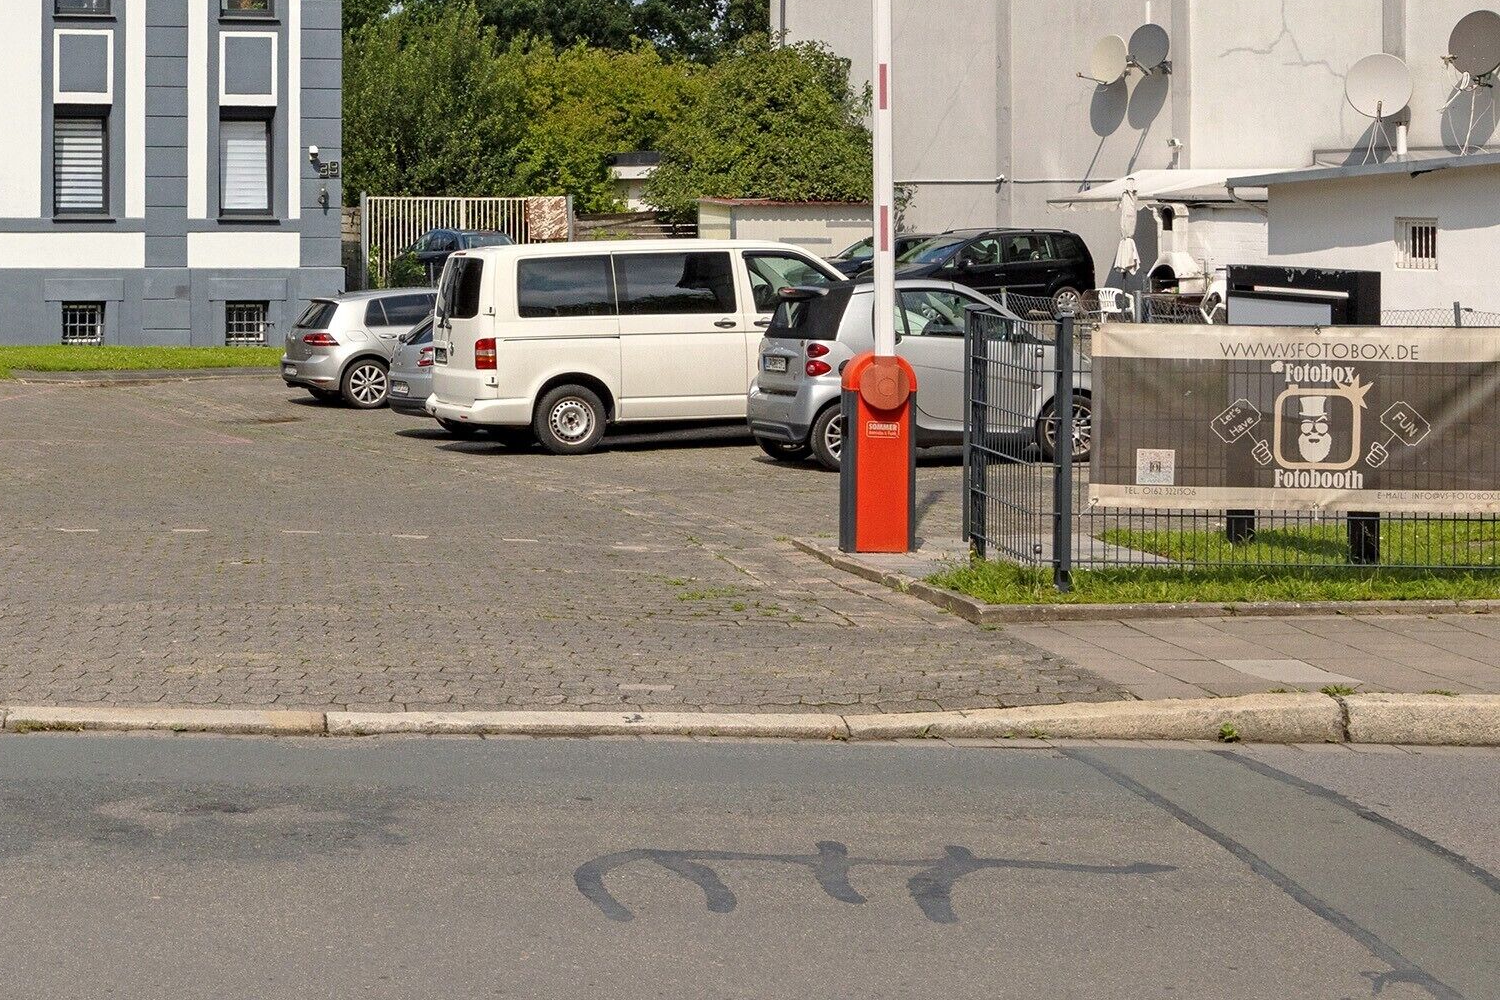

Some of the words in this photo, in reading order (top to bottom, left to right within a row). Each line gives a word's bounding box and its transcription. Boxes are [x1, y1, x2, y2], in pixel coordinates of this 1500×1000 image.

[320, 161, 339, 178] 39
[1220, 342, 1419, 360] WWW.VSFOTOBOX.DE
[1285, 363, 1355, 383] Fotobox
[1219, 407, 1242, 425] Let's
[1392, 411, 1419, 437] FUN
[868, 423, 898, 431] SOMMER
[1229, 416, 1254, 437] Have
[1274, 469, 1363, 489] Fotobooth
[1124, 487, 1140, 495] TEL.
[1142, 487, 1163, 496] 0162
